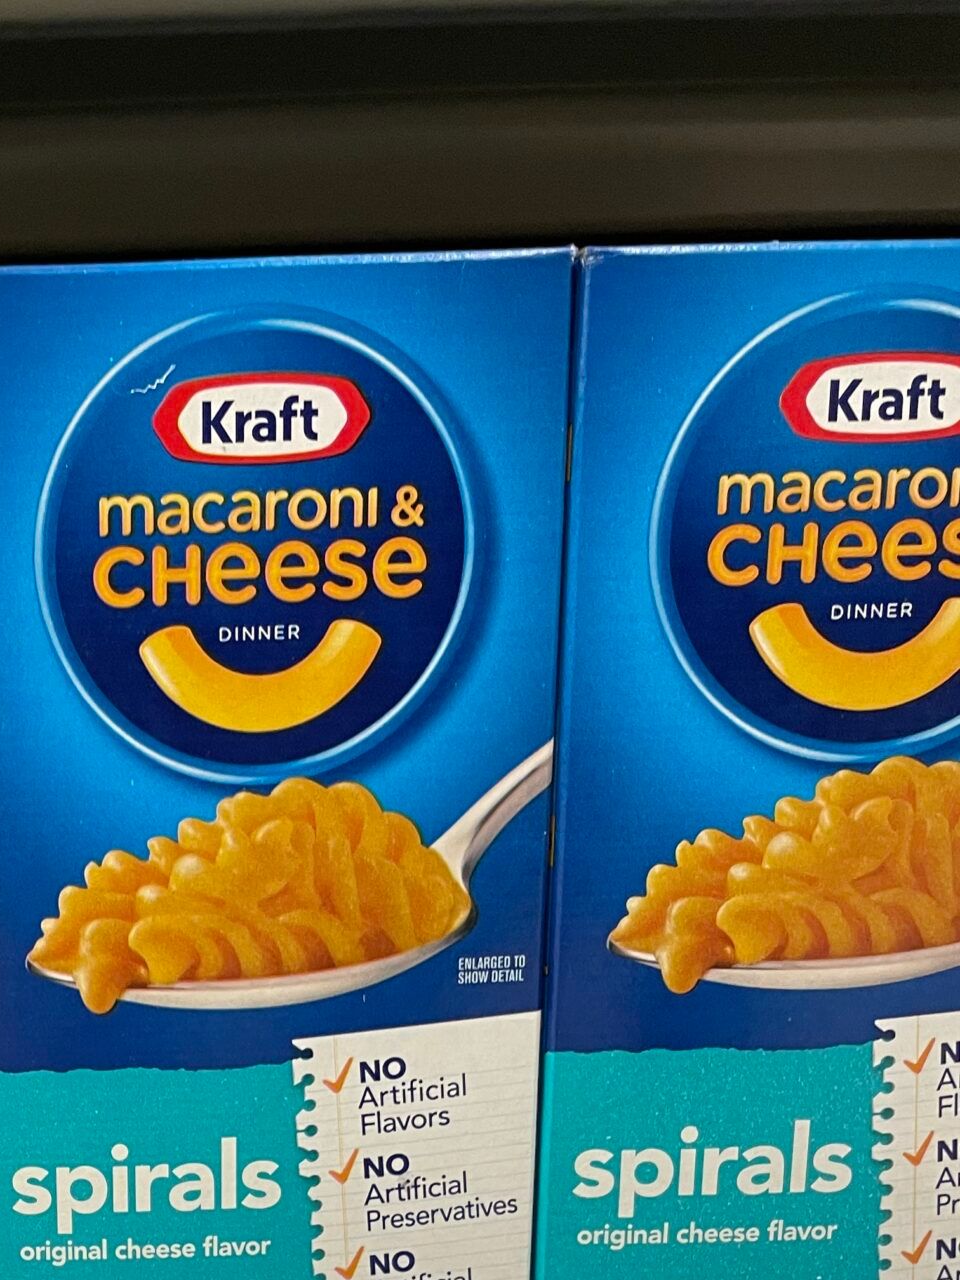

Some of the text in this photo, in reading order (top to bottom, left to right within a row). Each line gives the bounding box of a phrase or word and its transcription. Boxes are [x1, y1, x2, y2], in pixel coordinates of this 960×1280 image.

[202, 395, 318, 444] Kraft
[828, 374, 946, 422] Kraft
[98, 485, 424, 537] macaroni &
[219, 625, 300, 642] DINNER
[831, 602, 912, 620] DINNER
[12, 1137, 281, 1234] spirals
[572, 1119, 852, 1218] spirals
[20, 1235, 271, 1266] original cheese flavor
[577, 1220, 837, 1251] original cheese flavor
